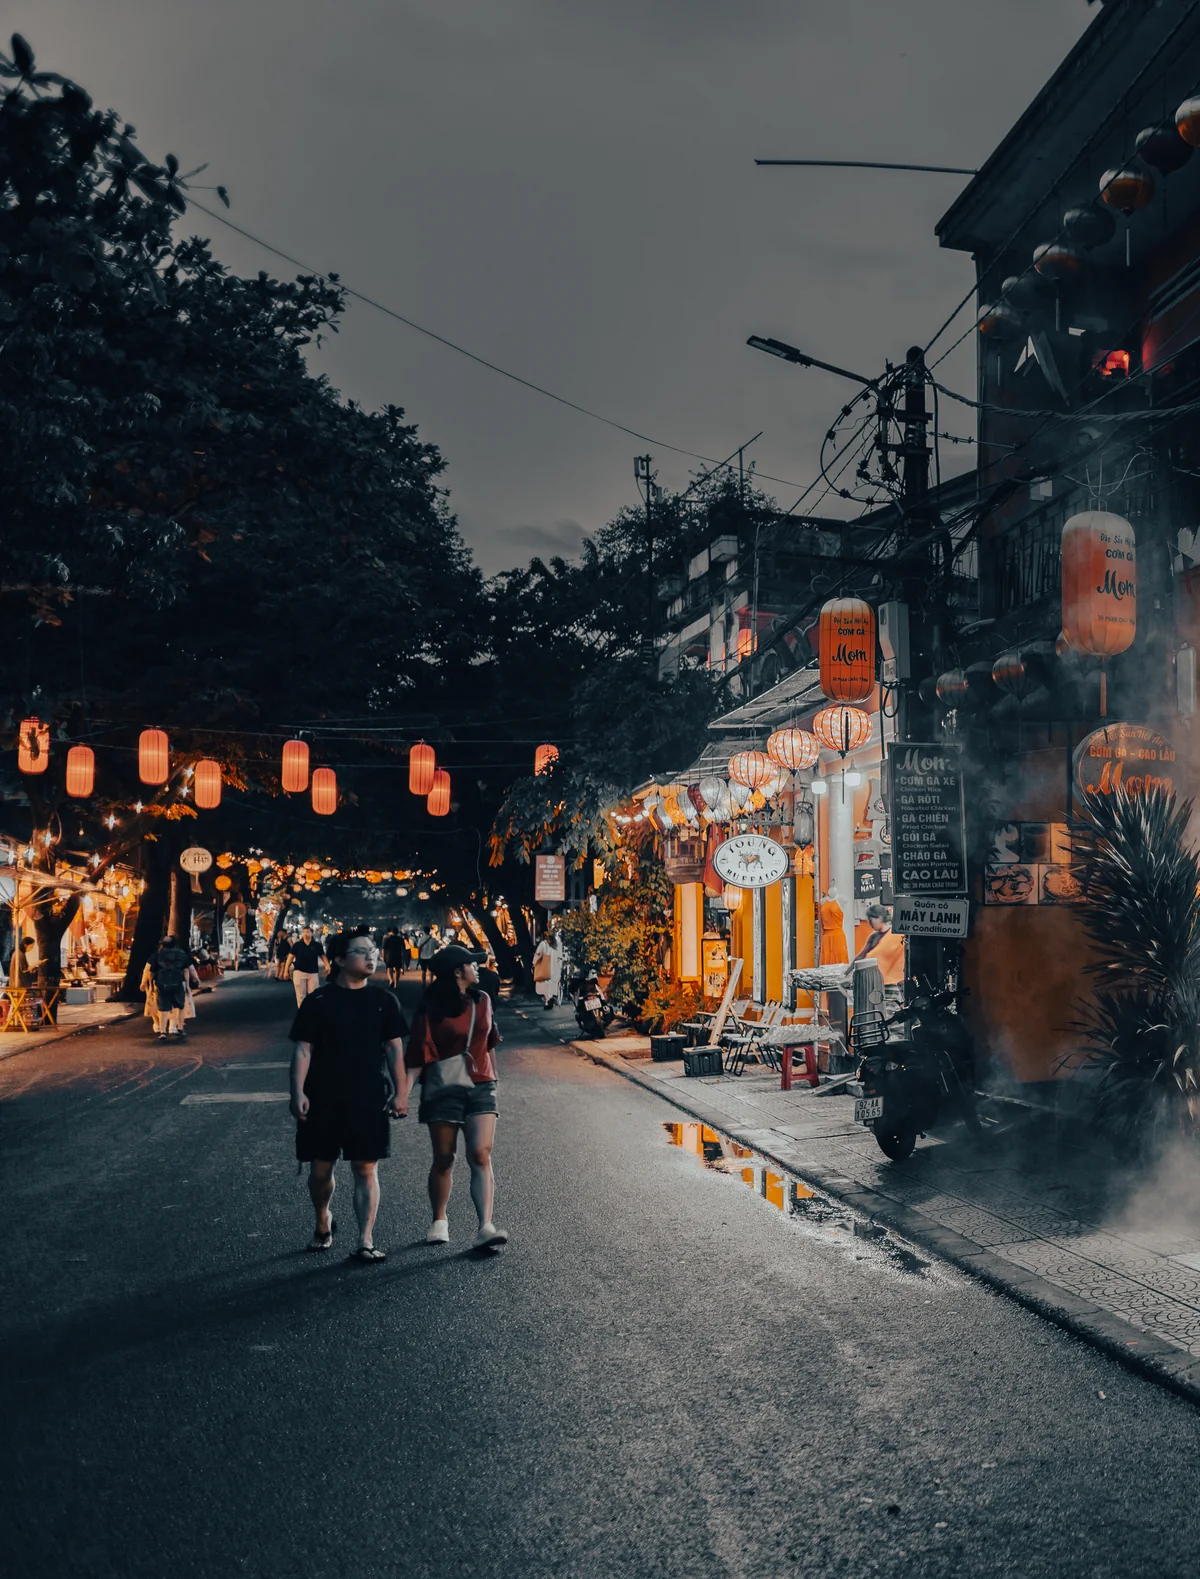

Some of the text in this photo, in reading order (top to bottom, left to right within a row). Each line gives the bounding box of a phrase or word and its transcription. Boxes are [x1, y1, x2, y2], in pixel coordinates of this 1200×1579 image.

[1097, 570, 1136, 600] Mom
[832, 644, 867, 666] Mom
[1138, 749, 1156, 760] CAO
[901, 776, 923, 785] CƠM
[927, 775, 940, 785] GÀ
[901, 794, 915, 804] GÀ
[902, 813, 915, 823] GÀ
[923, 831, 936, 841] GÀ
[727, 838, 777, 856] YOUNG
[934, 850, 947, 860] GÀ
[726, 869, 778, 883] BUFFALO
[902, 870, 930, 880] CAO
[914, 901, 948, 909] Quán có
[901, 909, 960, 926] MÁY LẠNH
[899, 924, 960, 934] Air Conditioner
[859, 1099, 879, 1110] 92-AA
